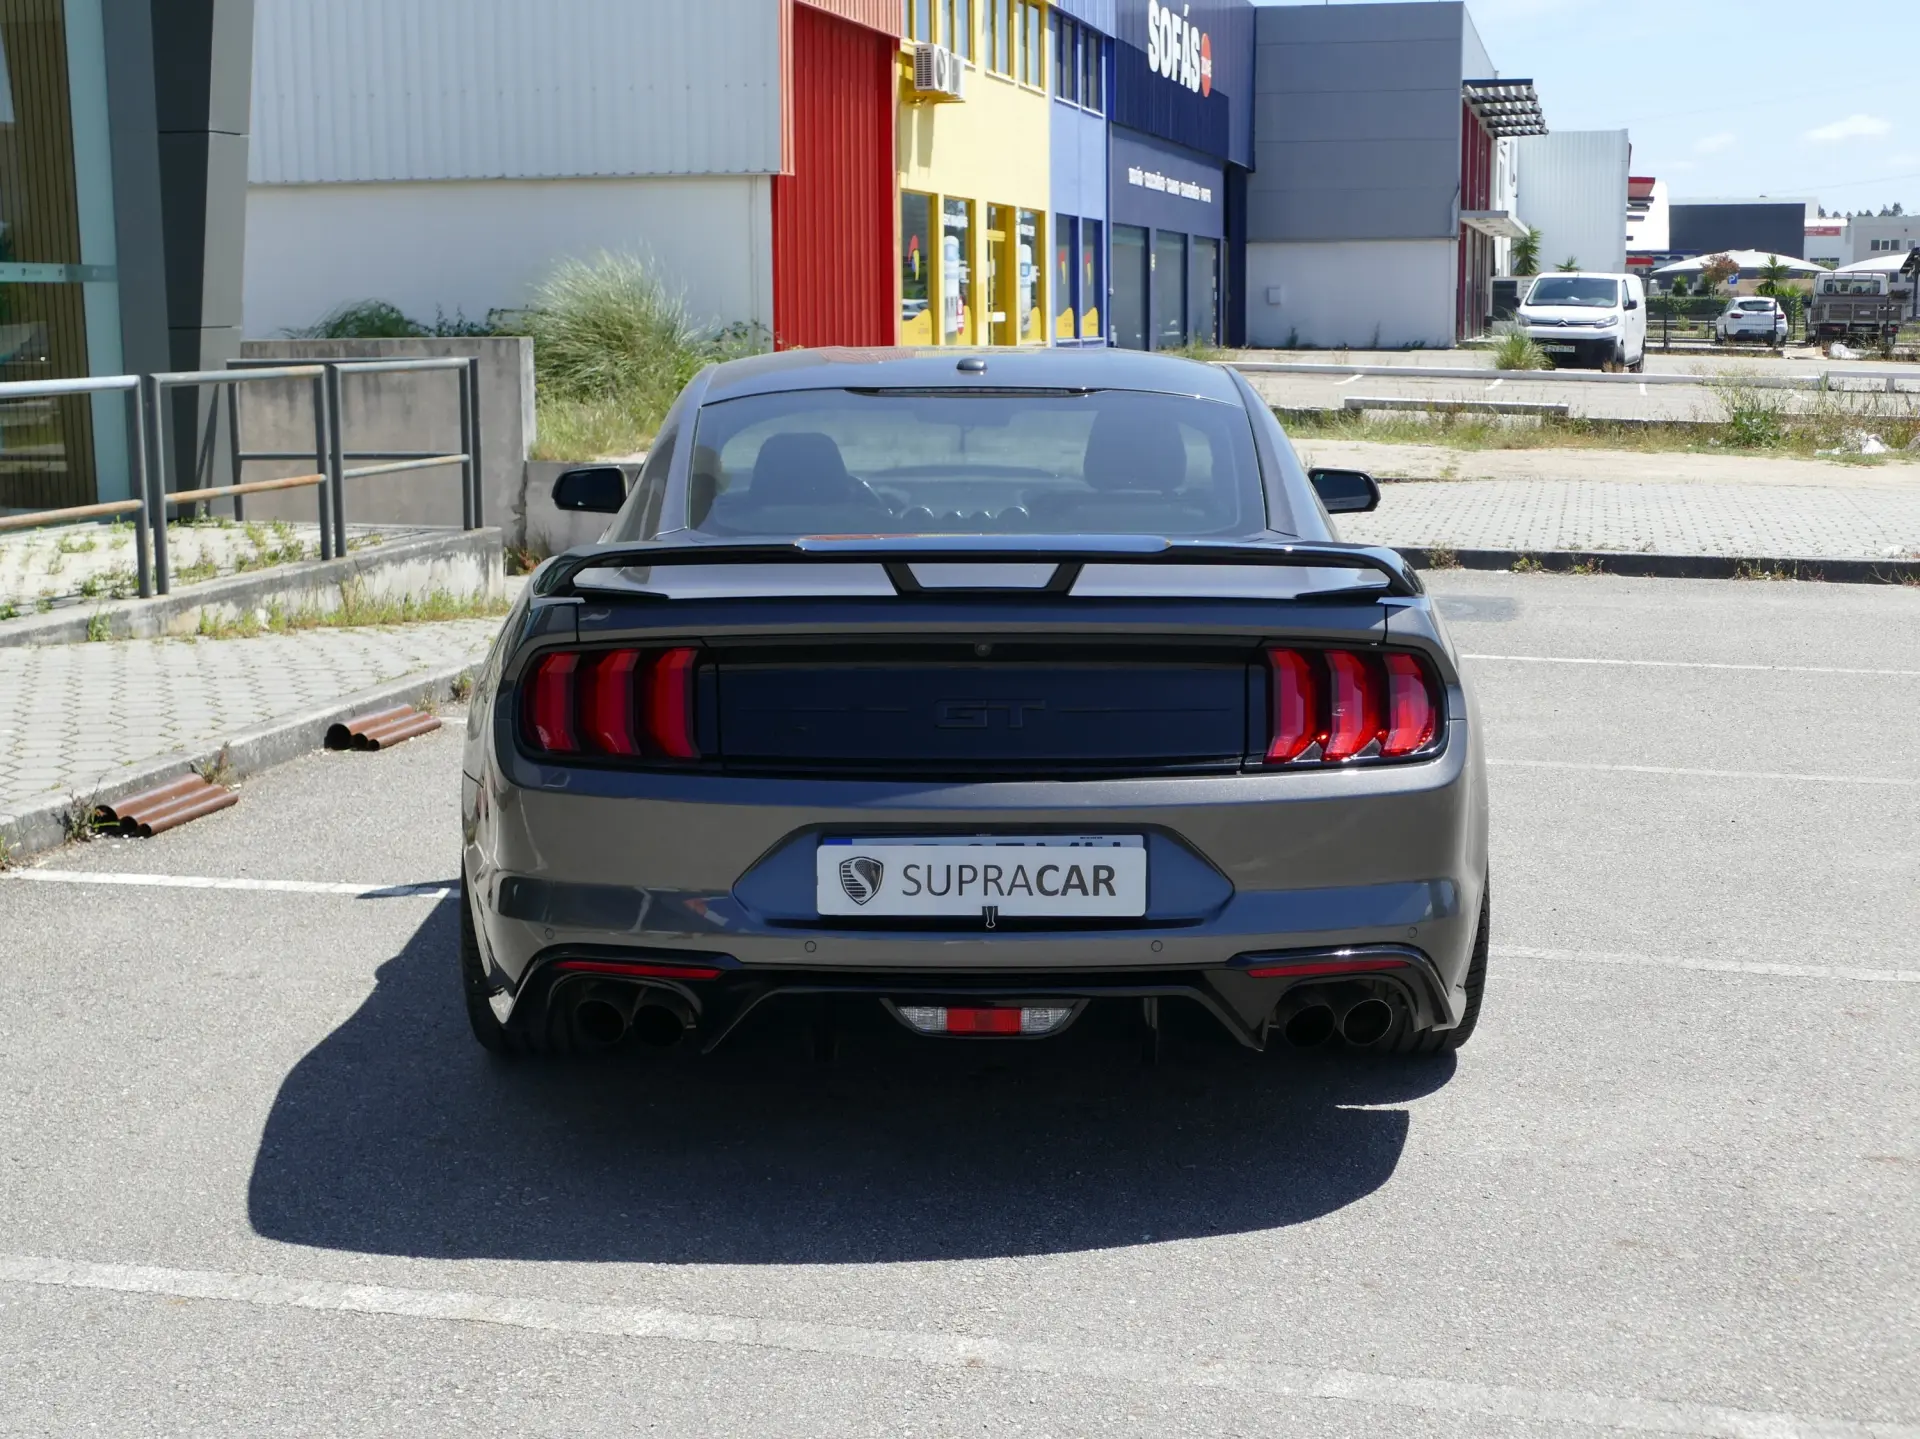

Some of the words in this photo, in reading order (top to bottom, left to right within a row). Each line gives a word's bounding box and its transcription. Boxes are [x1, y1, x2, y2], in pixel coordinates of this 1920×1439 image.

[1148, 0, 1200, 93] SOFÁS
[933, 699, 1046, 728] GT
[902, 864, 1117, 896] SUPRACAR
